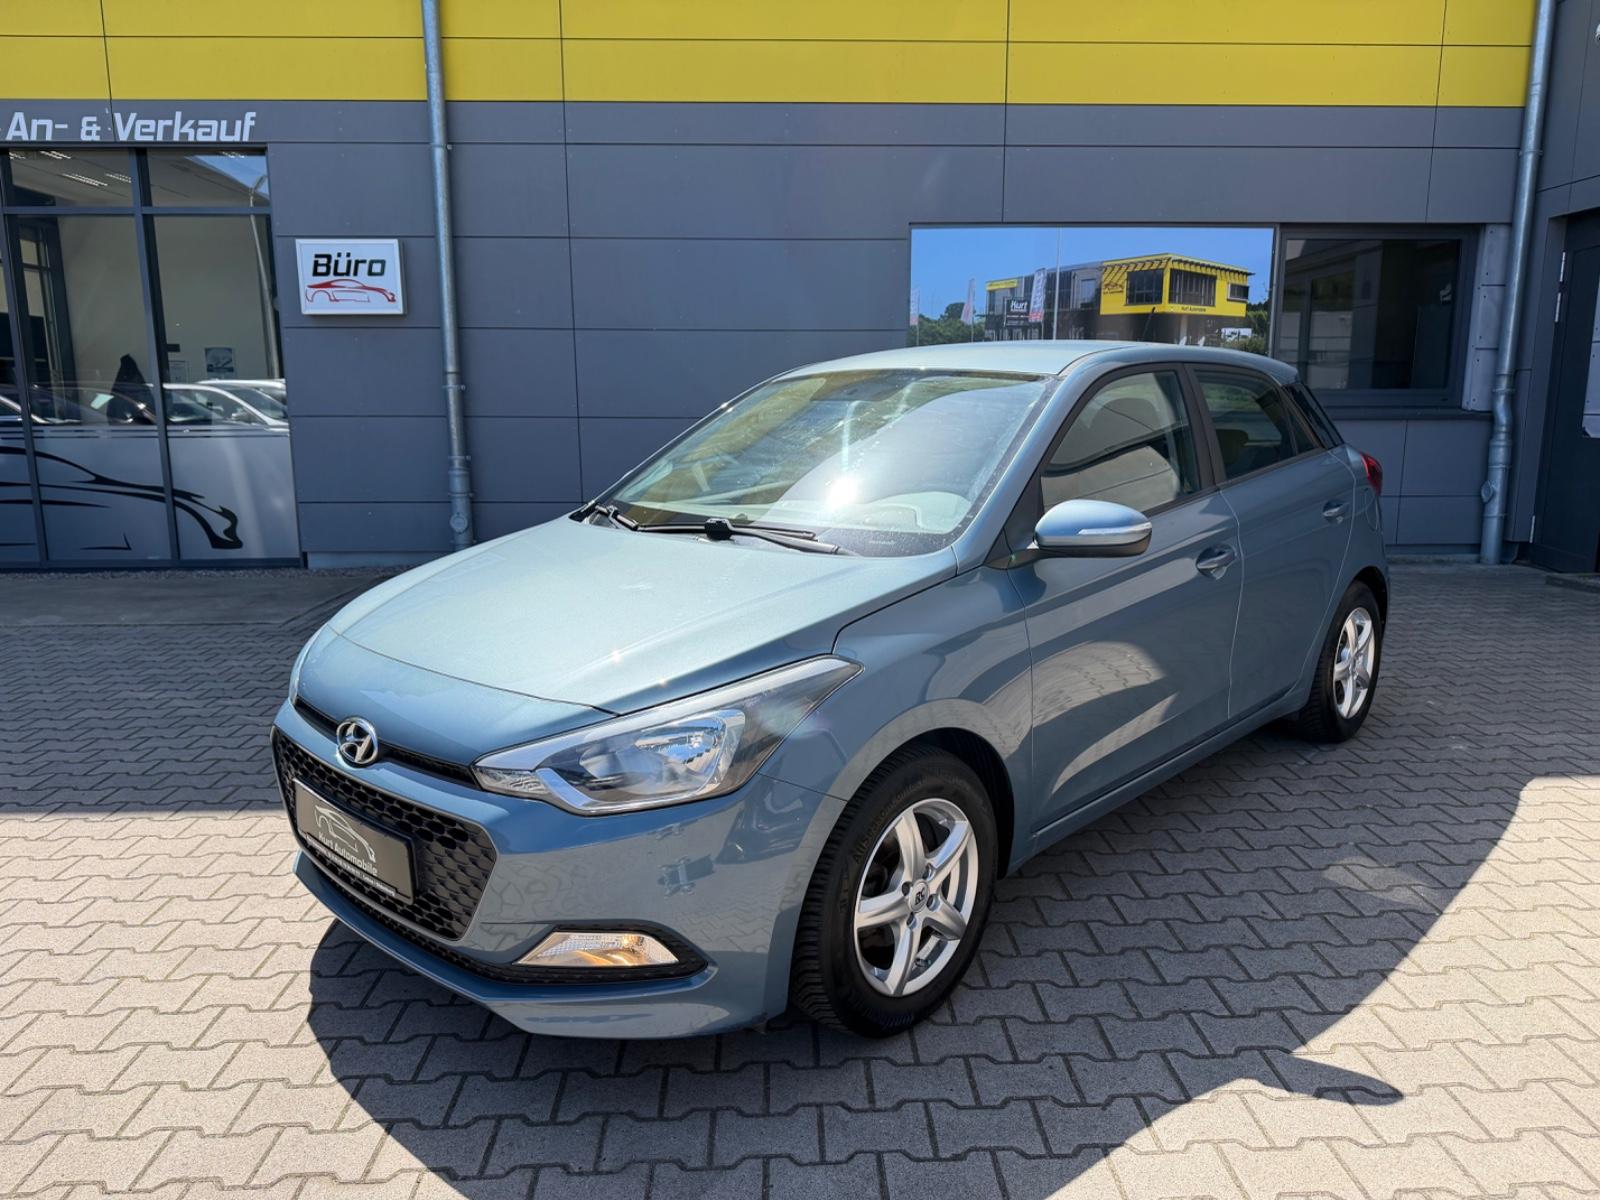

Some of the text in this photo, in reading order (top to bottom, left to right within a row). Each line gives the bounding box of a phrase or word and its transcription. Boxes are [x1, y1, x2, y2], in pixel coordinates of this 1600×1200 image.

[5, 111, 257, 142] An- & Verkauf
[312, 252, 387, 277] Büro
[318, 832, 378, 876] Kurt Automobile
